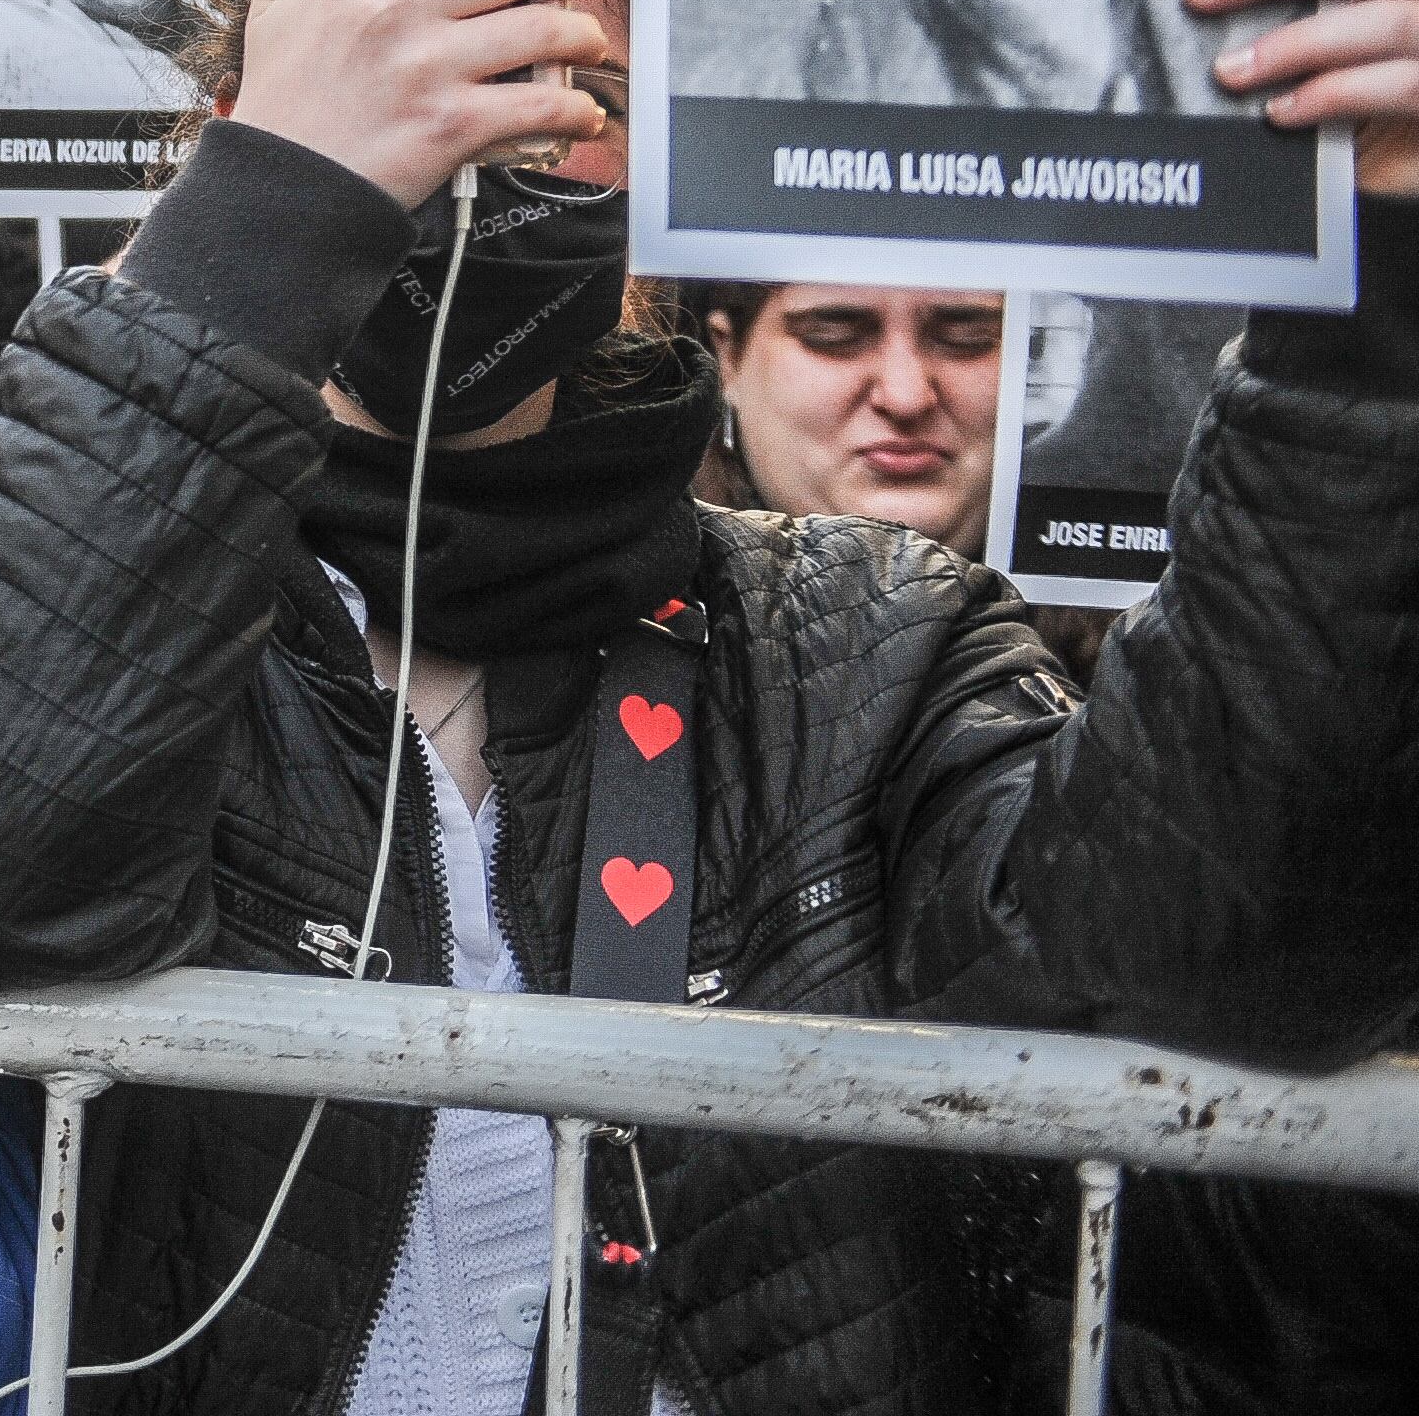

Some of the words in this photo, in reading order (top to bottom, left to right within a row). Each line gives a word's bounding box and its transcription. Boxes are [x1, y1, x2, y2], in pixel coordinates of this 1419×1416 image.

[56, 139, 127, 164] KOZUK
[132, 140, 161, 164] DE
[773, 146, 892, 192] MARIA
[899, 151, 1005, 197] LUISA
[1011, 156, 1201, 206] JAWORSKI
[1039, 520, 1104, 548] JOSE
[1108, 524, 1172, 552] ENRI
